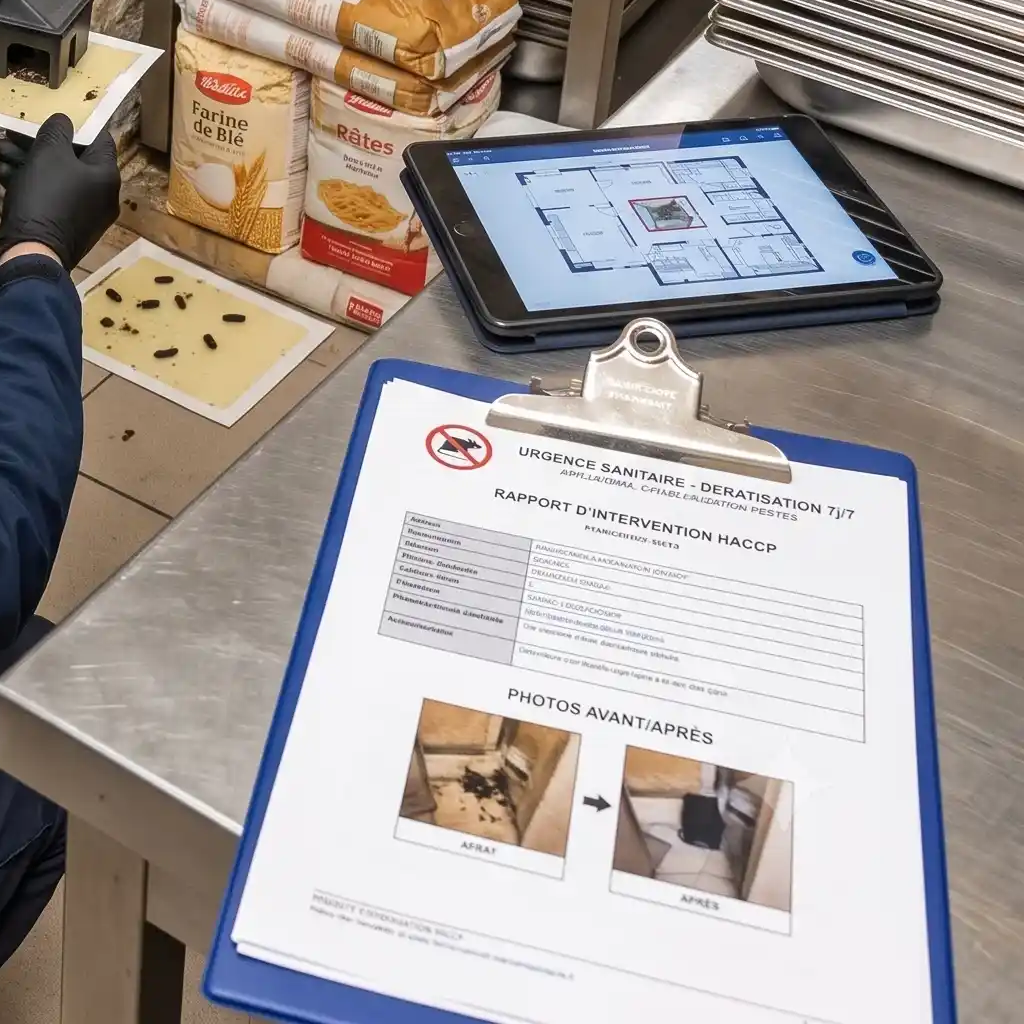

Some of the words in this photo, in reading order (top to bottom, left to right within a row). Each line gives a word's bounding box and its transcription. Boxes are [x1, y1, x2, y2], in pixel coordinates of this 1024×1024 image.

[192, 99, 249, 132] Farine
[193, 118, 213, 138] de
[216, 126, 244, 147] Blé
[519, 446, 597, 470] URGENCE
[600, 463, 686, 489] SANITAIRE
[700, 482, 822, 514] DERATISATION
[827, 505, 855, 520] 7j/7
[494, 487, 572, 513] RAPPORT
[576, 505, 713, 542] D'INTERVENTION
[718, 533, 777, 554] HACCP
[751, 506, 798, 522] PESTES
[507, 687, 582, 717] PHOTOS
[586, 705, 714, 746] AVANT/APRÈS
[679, 891, 720, 912] APRÈS
